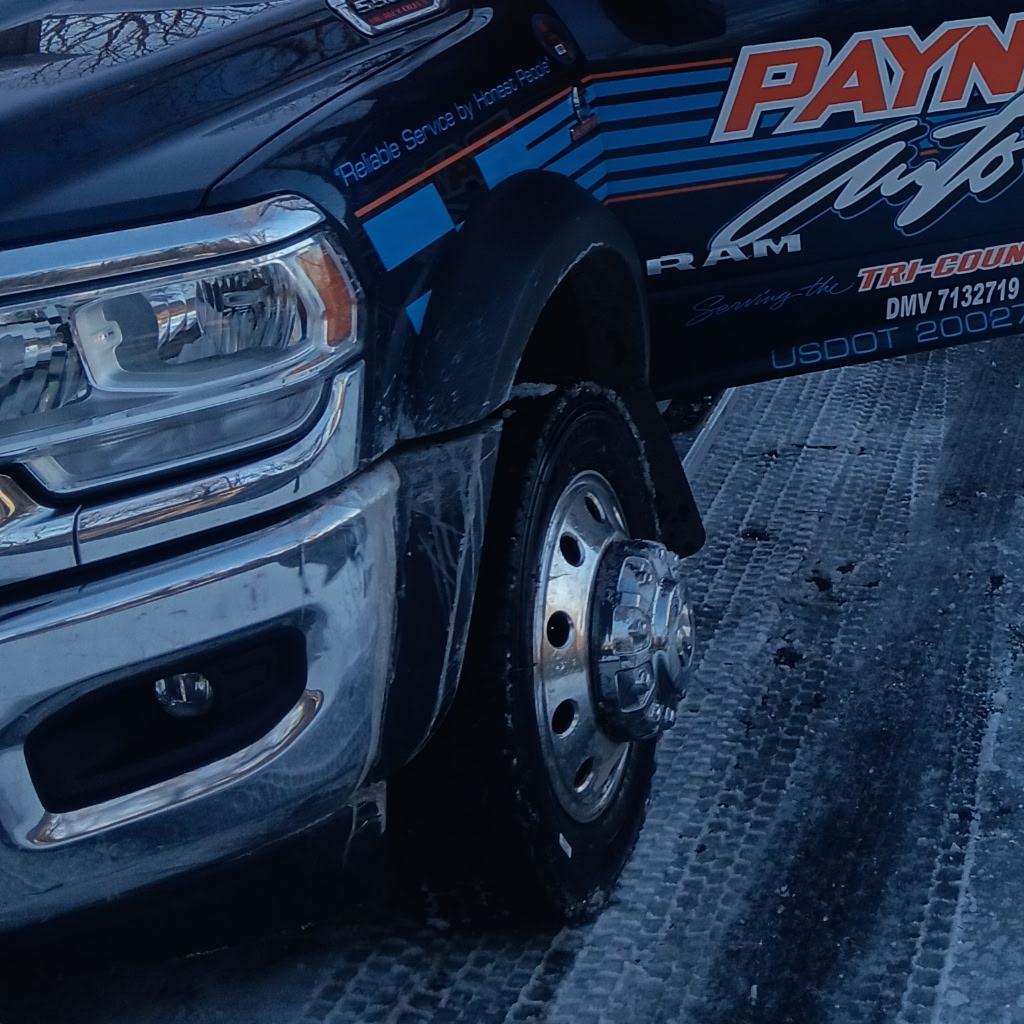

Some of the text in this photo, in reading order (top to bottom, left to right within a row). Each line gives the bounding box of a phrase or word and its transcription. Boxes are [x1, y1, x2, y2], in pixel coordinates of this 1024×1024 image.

[401, 110, 456, 151] Service
[455, 102, 475, 121] by
[472, 83, 519, 111] Honest
[646, 234, 802, 276] RAM
[686, 288, 800, 326] Serving
[798, 275, 854, 297] the
[886, 277, 1020, 319] DMV 7132719
[771, 327, 899, 369] USDOT
